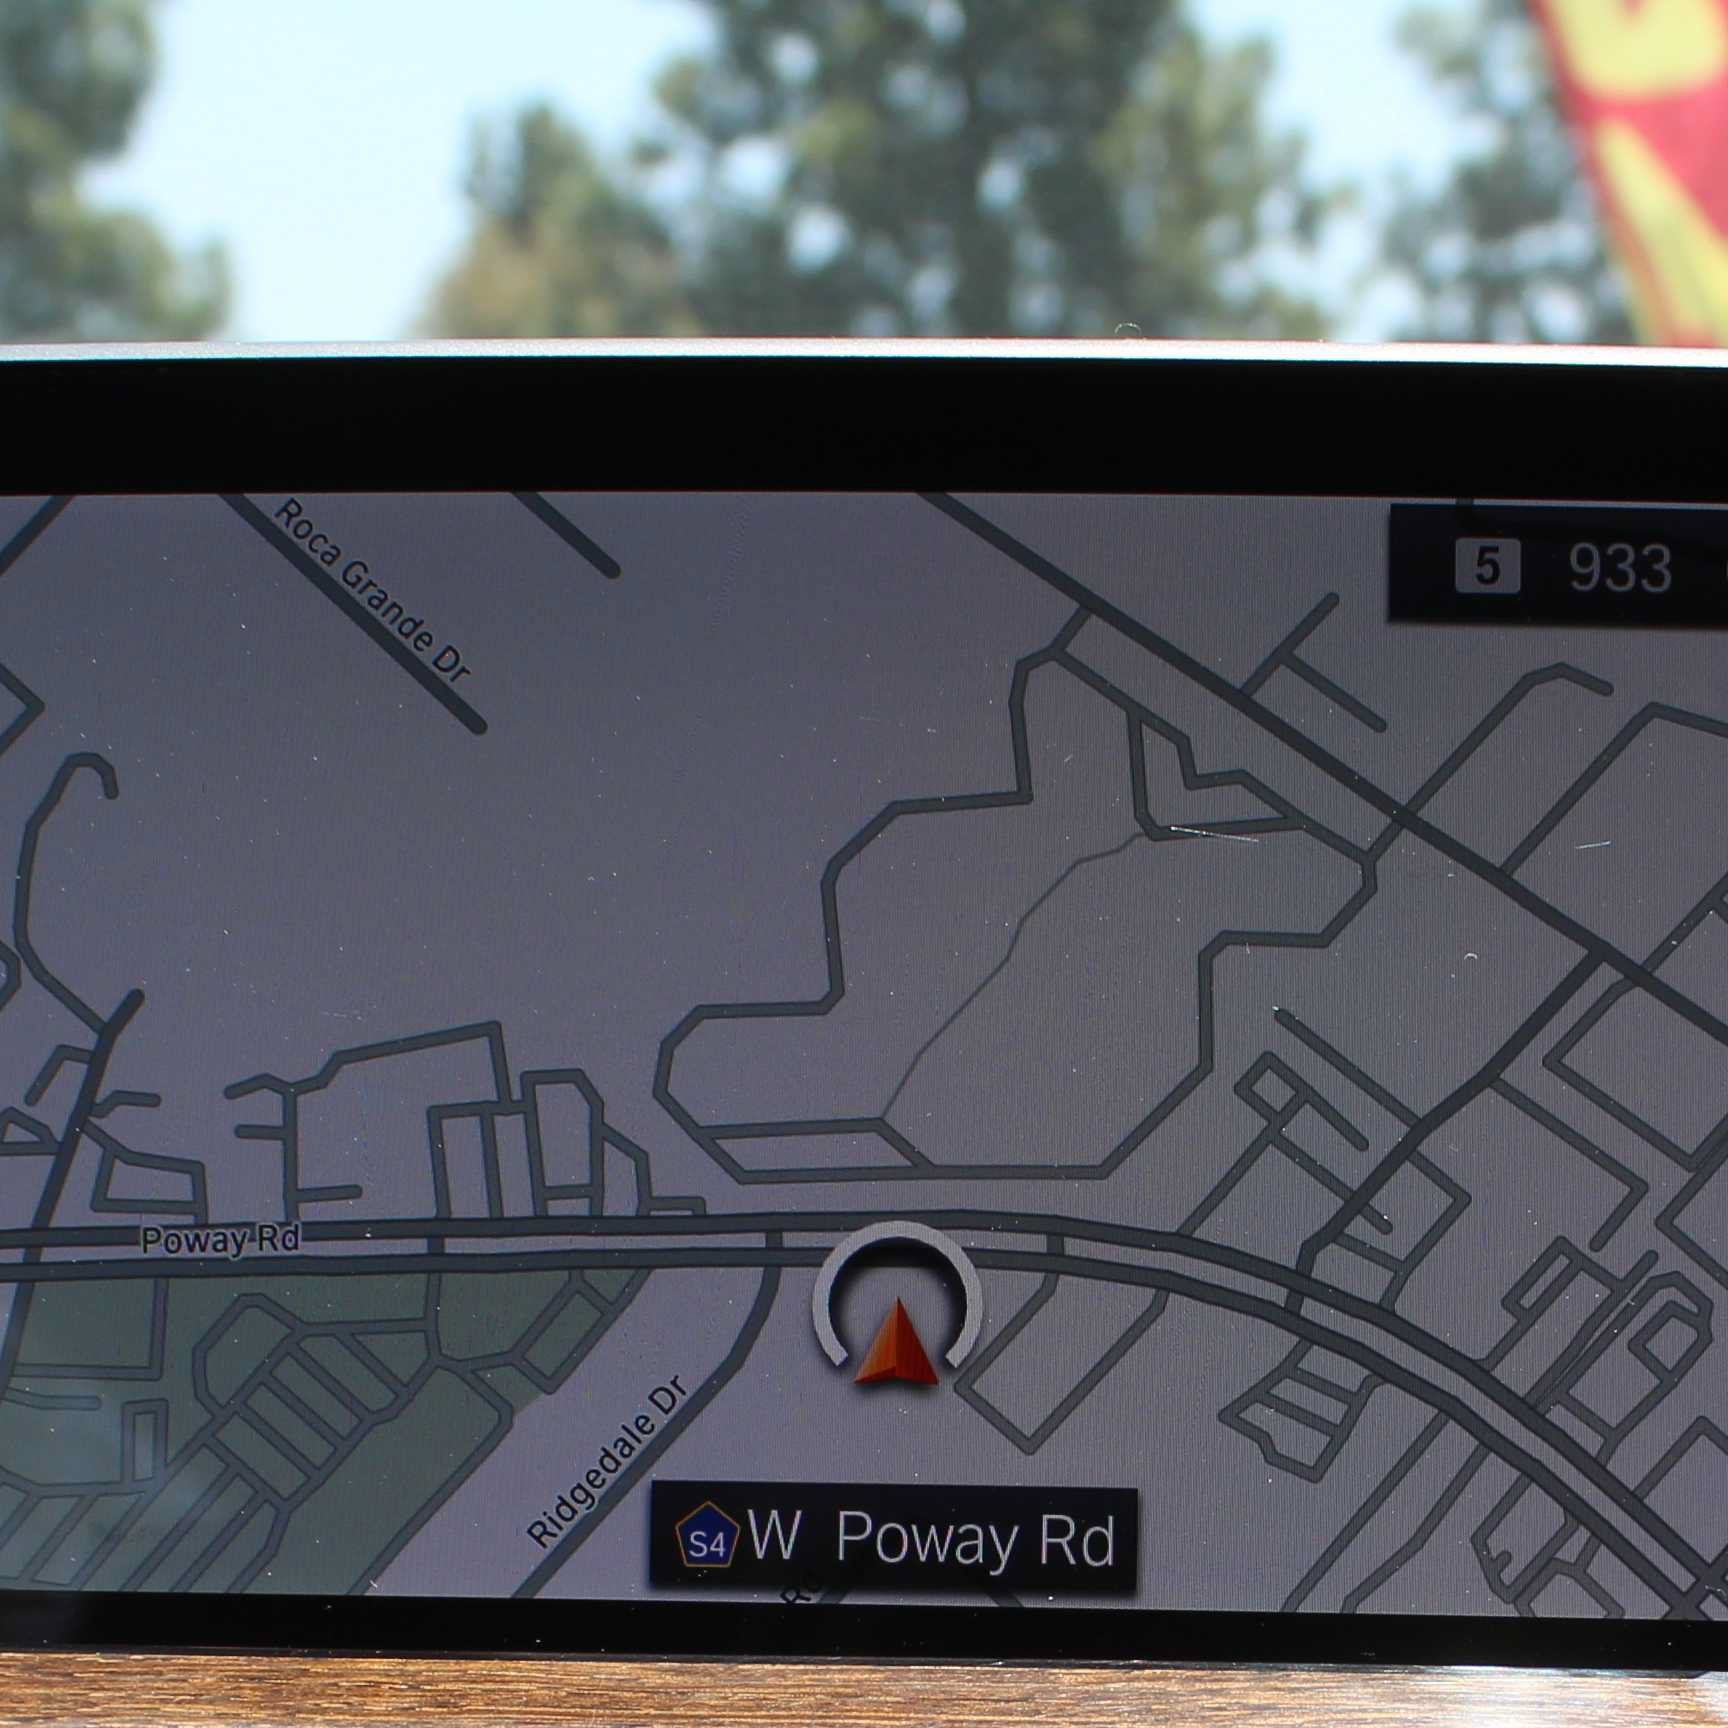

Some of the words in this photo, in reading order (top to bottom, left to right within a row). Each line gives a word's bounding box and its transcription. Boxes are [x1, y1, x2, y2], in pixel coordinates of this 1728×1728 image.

[1474, 544, 1501, 586] 5
[1569, 542, 1672, 592] 933
[274, 498, 342, 567] Roca
[342, 560, 433, 653] Grande
[431, 645, 472, 683] Dr
[142, 1226, 249, 1258] Poway
[258, 1223, 301, 1252] Rd
[526, 1414, 656, 1549] Ridgedale
[647, 1374, 687, 1416] Dr
[688, 1530, 726, 1559] S4
[747, 1508, 803, 1560] W
[838, 1509, 1020, 1576] Poway
[1040, 1513, 1115, 1567] Rd
